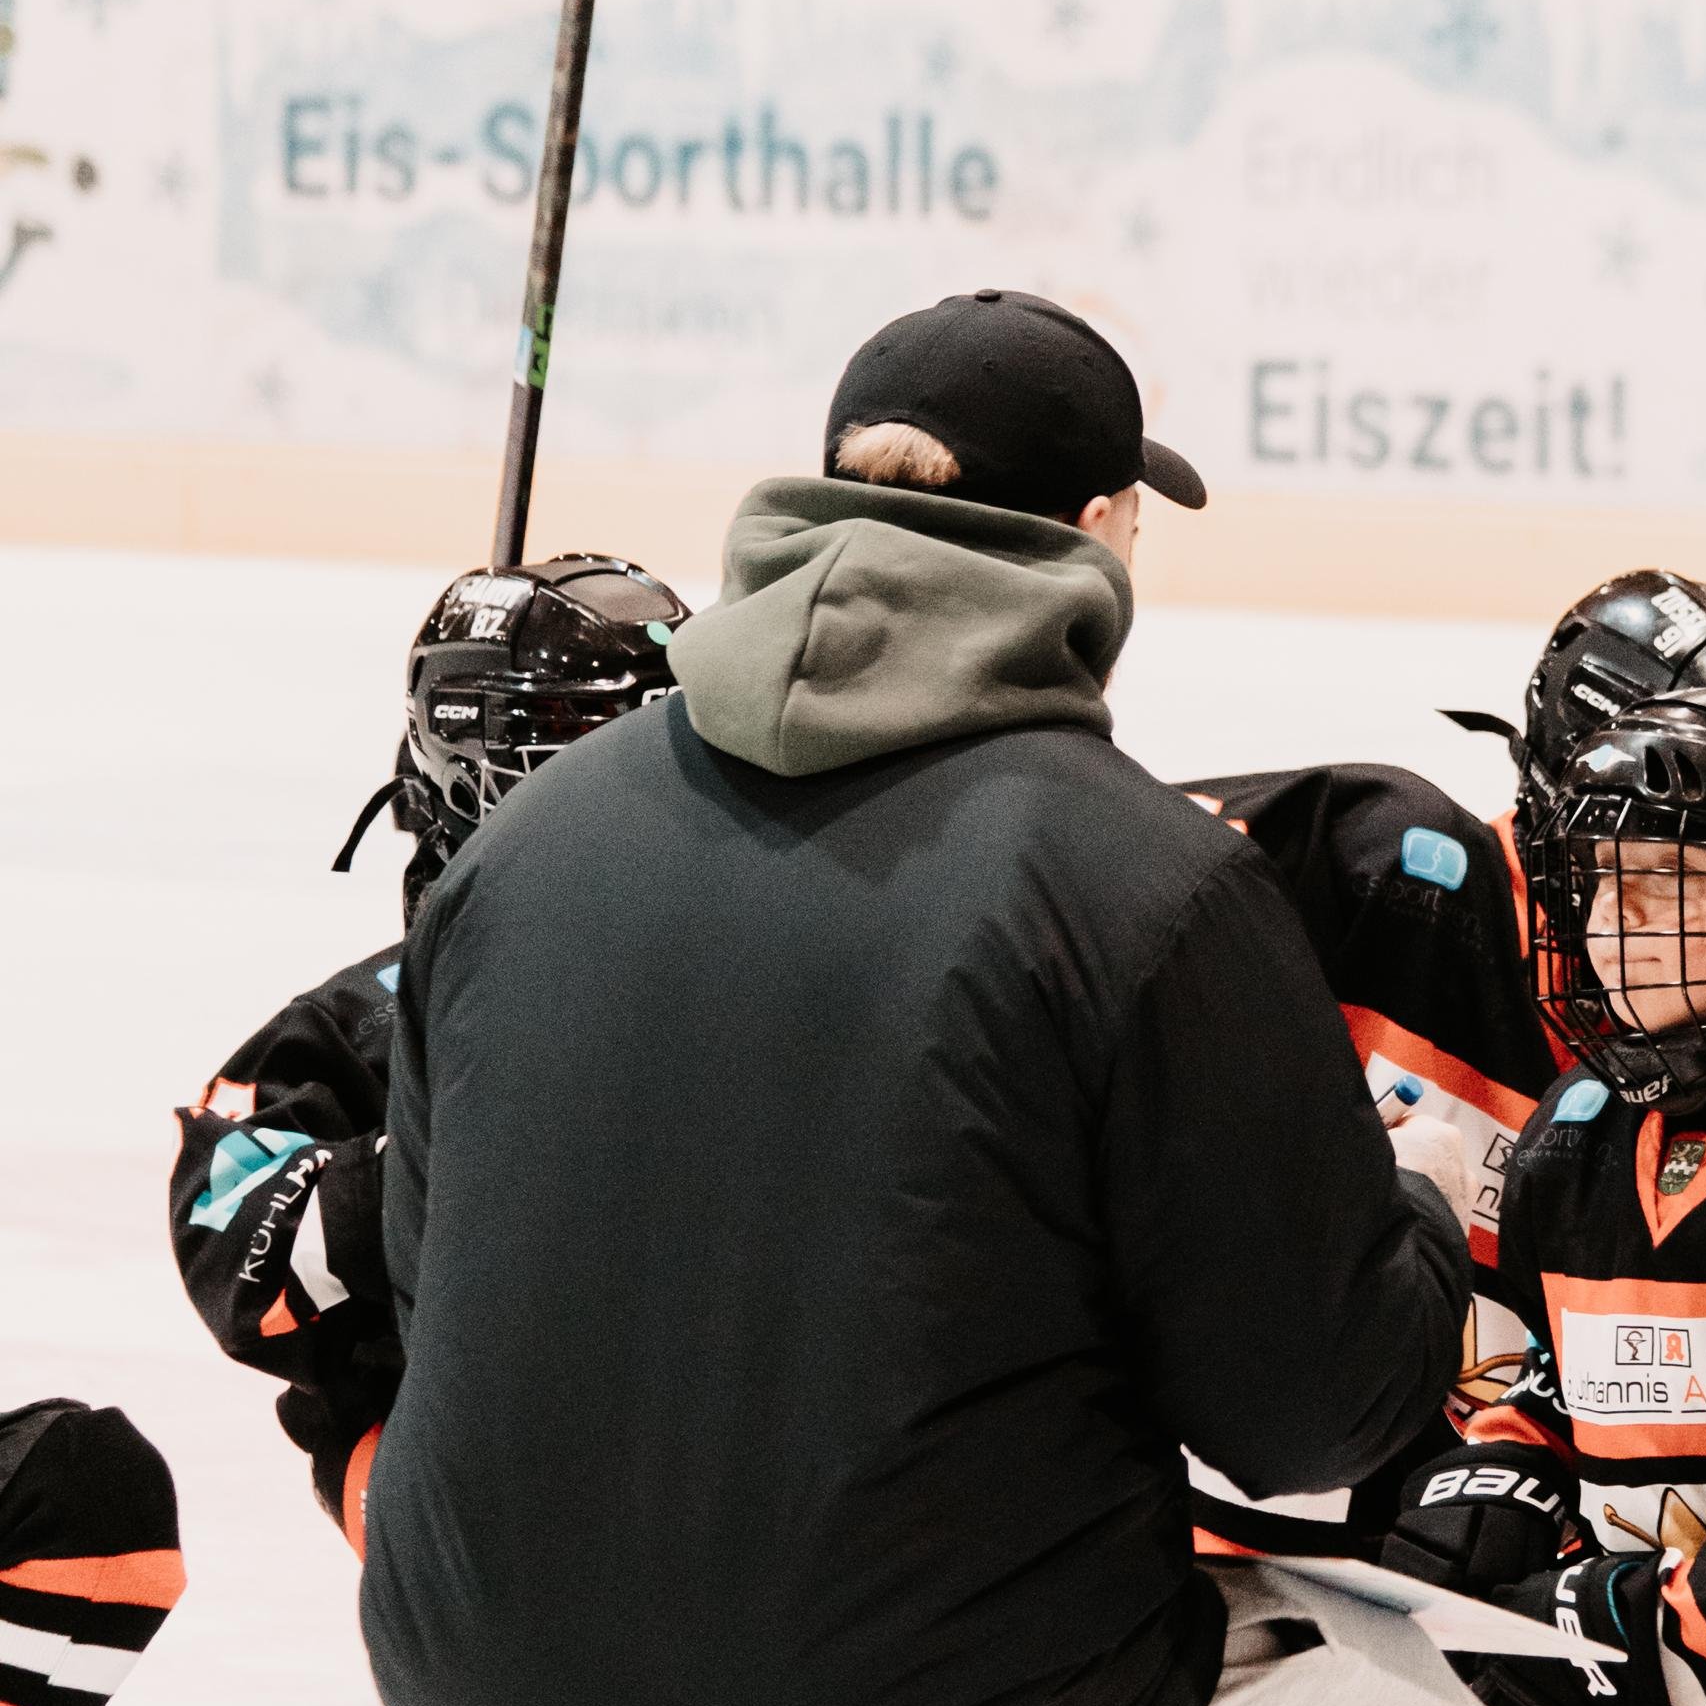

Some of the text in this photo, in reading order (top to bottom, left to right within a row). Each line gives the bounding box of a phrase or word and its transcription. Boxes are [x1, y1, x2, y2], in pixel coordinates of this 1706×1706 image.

[1246, 358, 1630, 479] Eiszeit!
[433, 704, 480, 721] CCM
[1572, 682, 1621, 719] CCM
